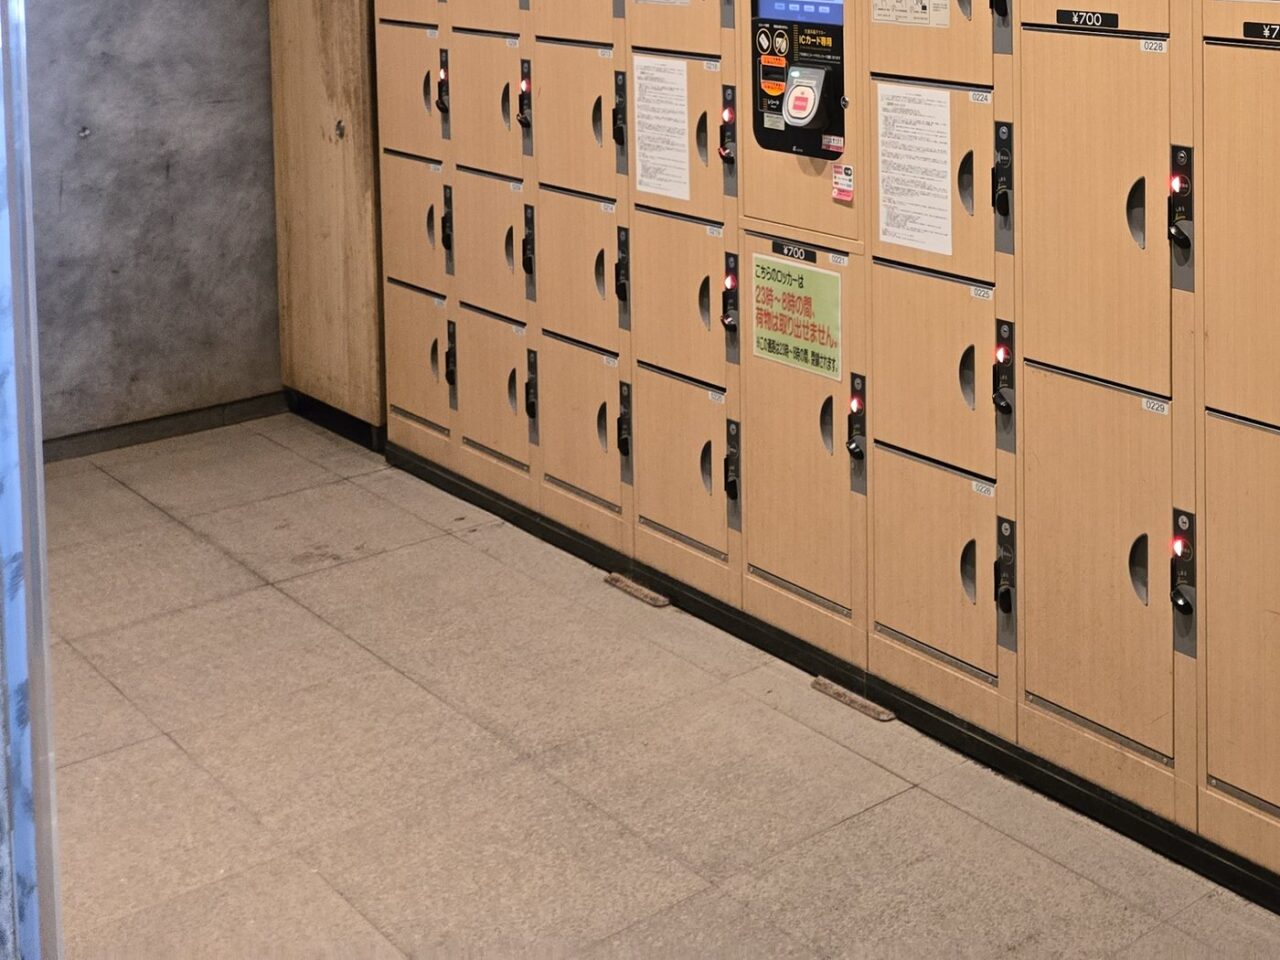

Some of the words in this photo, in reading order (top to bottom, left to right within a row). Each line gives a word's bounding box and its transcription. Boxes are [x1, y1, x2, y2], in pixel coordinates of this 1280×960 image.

[1072, 12, 1102, 25] ¥700
[1144, 41, 1163, 51] 0228
[972, 92, 989, 102] 0224
[783, 245, 805, 259] ¥700
[832, 254, 846, 264] 0221
[756, 263, 805, 288] こちらのロッカーは
[973, 287, 990, 299] 0225
[1145, 399, 1165, 414] 0229
